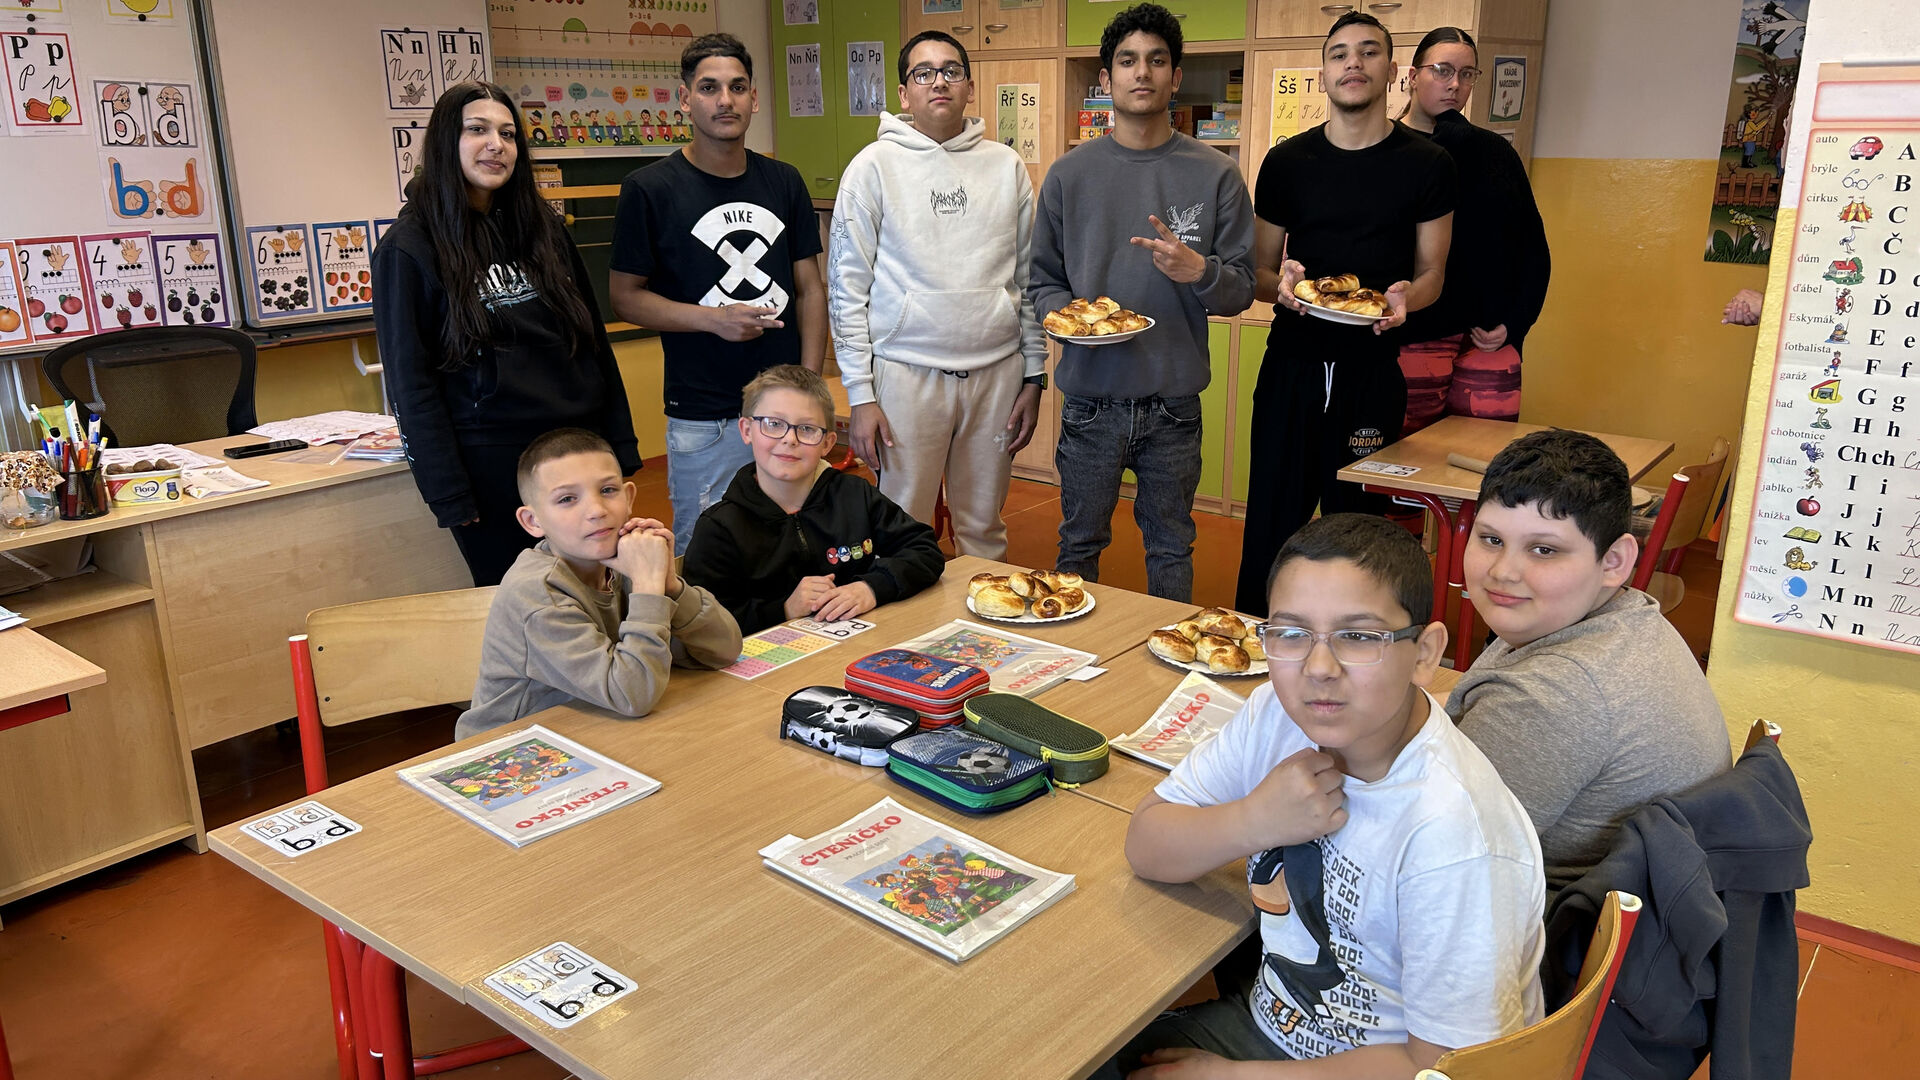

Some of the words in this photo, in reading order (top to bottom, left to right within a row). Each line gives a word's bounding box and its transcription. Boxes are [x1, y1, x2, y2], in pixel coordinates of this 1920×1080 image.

[8, 35, 29, 59] P
[45, 42, 64, 66] p
[387, 33, 404, 54] N
[411, 39, 424, 54] n
[440, 35, 458, 54] H
[469, 36, 481, 54] h
[789, 53, 802, 64] Nn
[805, 48, 818, 63] Ňň
[851, 50, 864, 62] Oo
[868, 50, 881, 64] Pp
[19, 64, 36, 91] P
[42, 75, 71, 100] p
[1278, 75, 1297, 94] Šš
[1001, 90, 1015, 106] Řř
[1021, 93, 1035, 106] Ss
[101, 100, 137, 145] b
[158, 103, 188, 145] d
[396, 130, 412, 148] D
[1815, 136, 1838, 144] auto
[1897, 143, 1916, 160] A
[1811, 164, 1838, 175] brýle
[113, 162, 149, 216] b
[167, 163, 200, 216] d
[1894, 174, 1912, 192] B
[1806, 193, 1838, 203] cirkus
[723, 210, 753, 224] NIKE
[1888, 206, 1908, 224] C
[1802, 224, 1820, 236] čáp
[258, 236, 267, 264] 6
[321, 232, 332, 260] 7
[1883, 232, 1903, 255] Č
[18, 249, 30, 281] 3
[92, 245, 107, 276] 4
[164, 245, 176, 275] 5
[1797, 254, 1820, 263] dům
[1878, 268, 1897, 286] D
[1793, 283, 1822, 293] ďábel
[1872, 294, 1892, 316] Ď
[1788, 312, 1835, 325] Eskymák
[1867, 328, 1886, 346] E
[1904, 335, 1916, 348] e
[1784, 342, 1831, 354] fotbalista
[1779, 371, 1807, 381] garáž
[1865, 359, 1881, 375] F
[1900, 361, 1913, 378] f
[1775, 398, 1793, 409] had
[1857, 388, 1877, 405] G
[1891, 395, 1907, 413] g
[1771, 427, 1826, 440] chobotnice
[1851, 417, 1872, 435] H
[1886, 420, 1901, 437] h
[1348, 436, 1384, 447] JORDAN
[1766, 455, 1798, 466] indián
[1837, 445, 1867, 464] Ch
[1871, 450, 1896, 467] ch
[134, 485, 156, 493] Flora
[1760, 482, 1793, 494] jablko
[1848, 474, 1859, 491] I
[1879, 479, 1888, 495] i
[1758, 510, 1790, 521] knížka
[1840, 503, 1855, 519] J
[1871, 507, 1883, 528] j
[1753, 536, 1768, 546] lev
[1832, 530, 1854, 547] K
[1866, 535, 1881, 552] k
[1749, 564, 1777, 575] měsíc
[1830, 558, 1846, 575] L
[1865, 563, 1873, 579] l
[1744, 590, 1774, 603] nůžky
[1821, 585, 1846, 603] M
[1853, 594, 1874, 608] m
[1818, 613, 1837, 631] N
[1851, 622, 1865, 635] n
[515, 780, 629, 829] ČTENÍČKO
[280, 838, 316, 851] b
[326, 819, 354, 837] d
[798, 816, 902, 866] ČTENÍČKO
[1331, 857, 1361, 889] DUCK
[554, 952, 587, 974] d
[539, 1000, 585, 1020] b
[592, 971, 625, 998] d
[1330, 990, 1373, 1012] DUCK
[1295, 1031, 1337, 1057] DUCK
